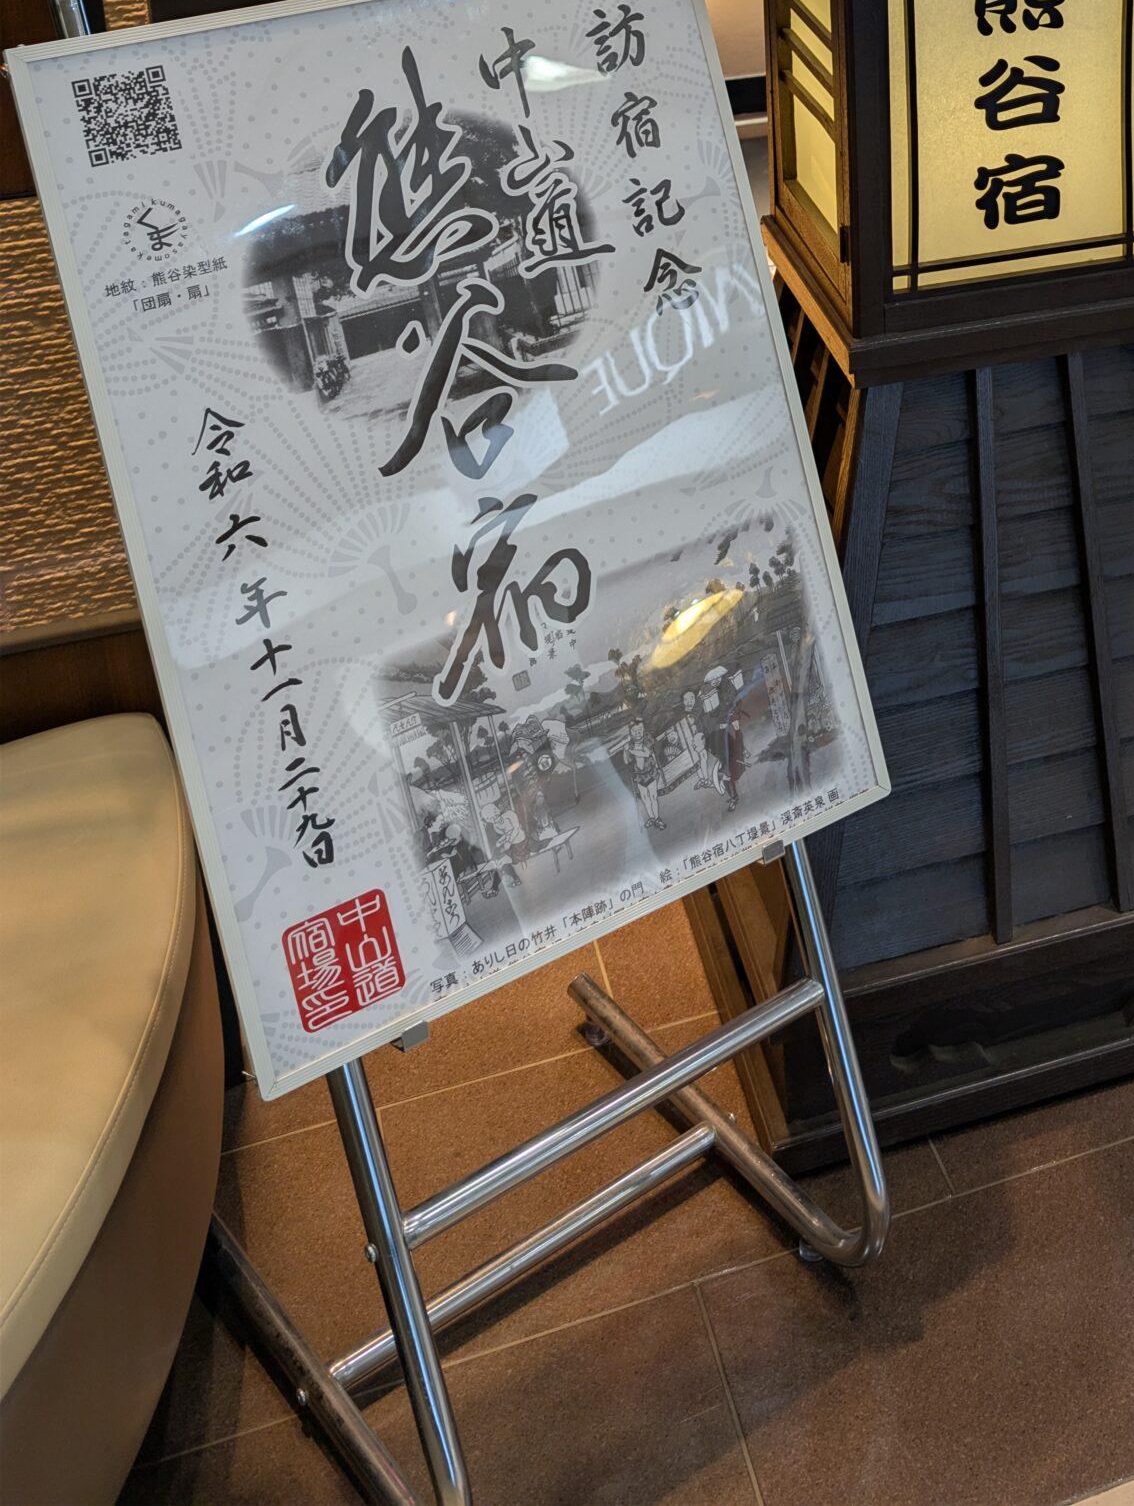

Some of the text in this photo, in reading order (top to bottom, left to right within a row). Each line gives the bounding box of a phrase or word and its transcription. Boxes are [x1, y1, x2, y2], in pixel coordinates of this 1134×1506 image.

[478, 26, 616, 274] 中山道
[585, 3, 702, 316] 訪宿記念
[326, 44, 592, 701] 熊谷宿
